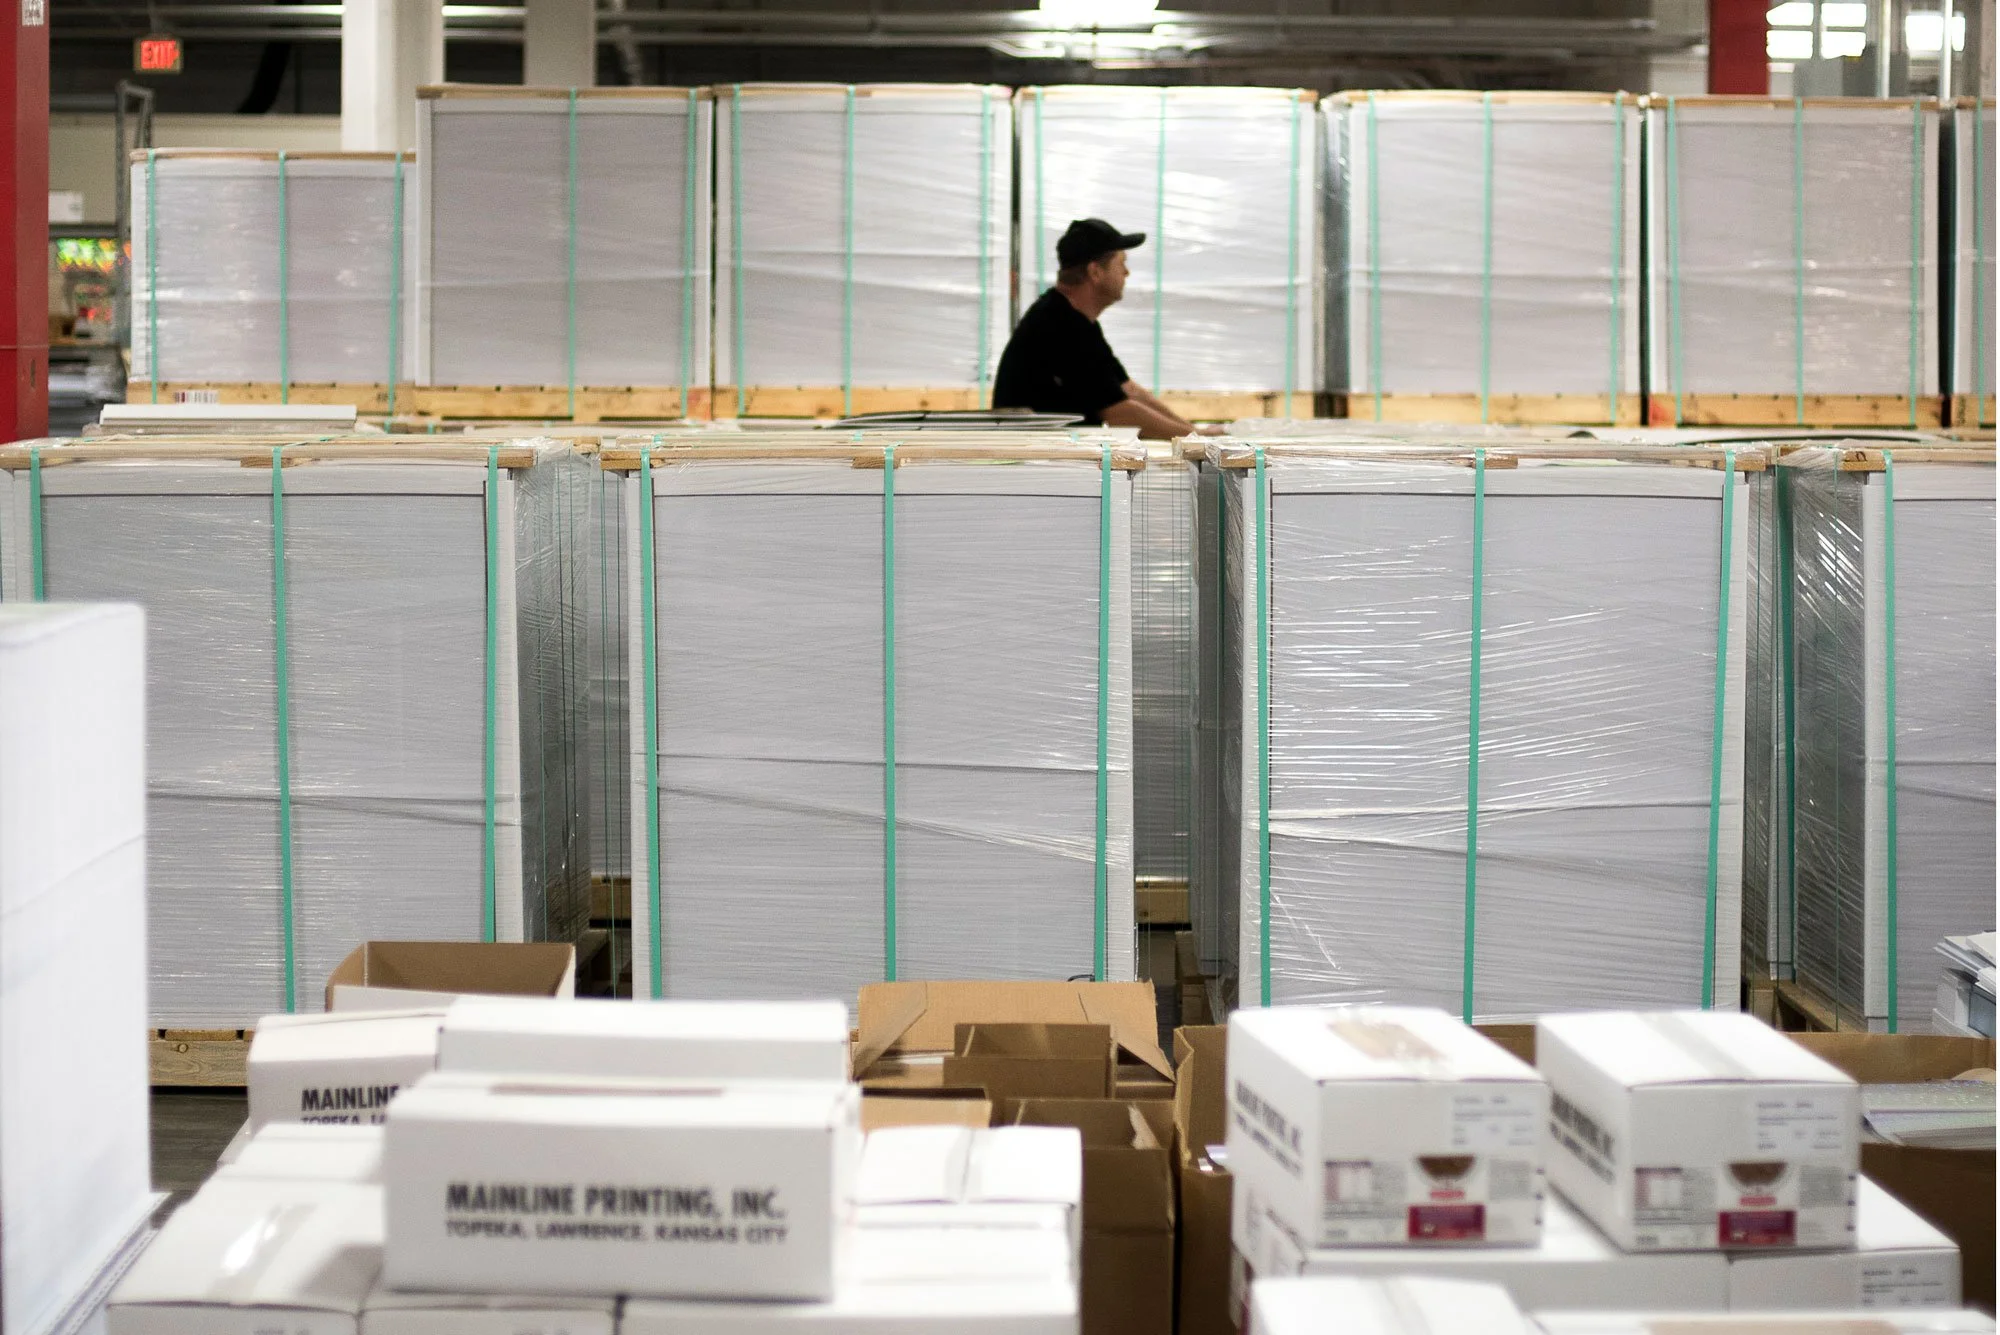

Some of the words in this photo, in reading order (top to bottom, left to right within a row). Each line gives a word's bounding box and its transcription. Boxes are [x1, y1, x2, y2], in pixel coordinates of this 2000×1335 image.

[141, 40, 175, 69] EXIT
[447, 1184, 574, 1215] MAINLINE
[584, 1187, 721, 1218] PRINTING,
[732, 1188, 787, 1219] INC.
[447, 1220, 528, 1240] TOPEKA,
[654, 1225, 738, 1243] KANSAS
[744, 1226, 788, 1245] CITY
